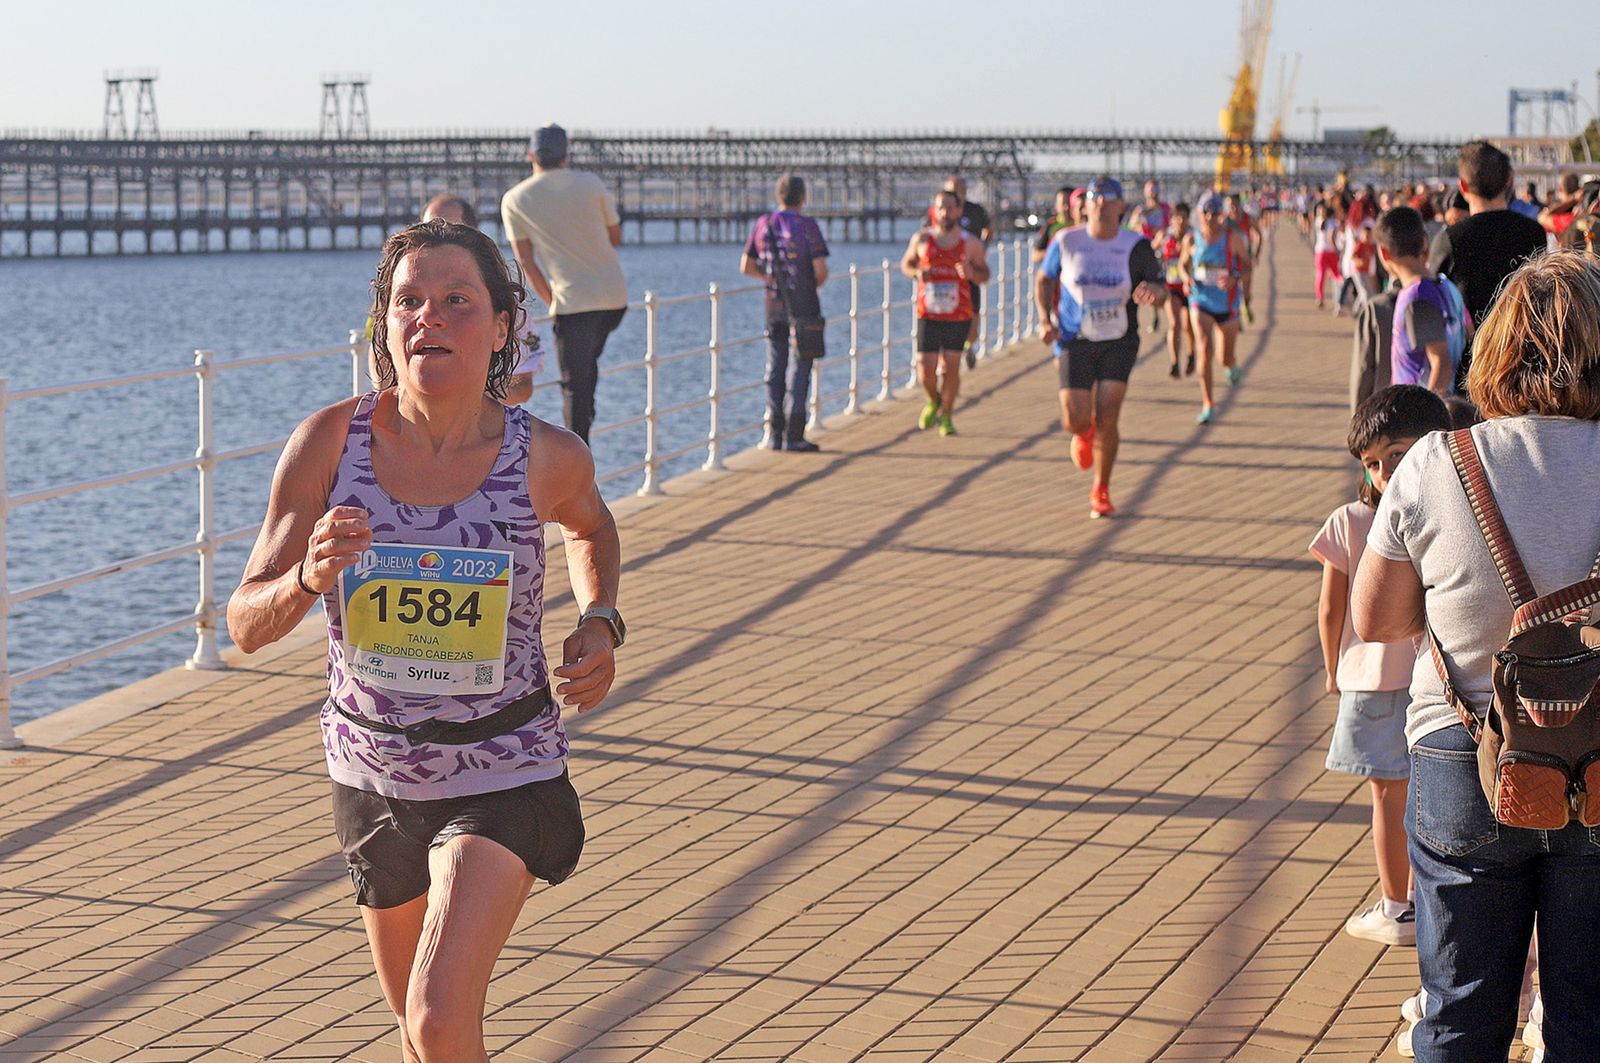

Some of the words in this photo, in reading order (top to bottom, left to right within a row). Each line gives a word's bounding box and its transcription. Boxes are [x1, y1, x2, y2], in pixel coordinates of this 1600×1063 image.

[377, 556, 414, 568] HUELVA
[452, 559, 497, 579] 2023
[369, 585, 482, 628] 1584
[408, 633, 440, 646] TANJA
[373, 642, 423, 658] REDONDO
[425, 649, 474, 661] CABEZAS
[357, 663, 398, 680] HYUNDAI
[407, 666, 450, 681] Syrluz
